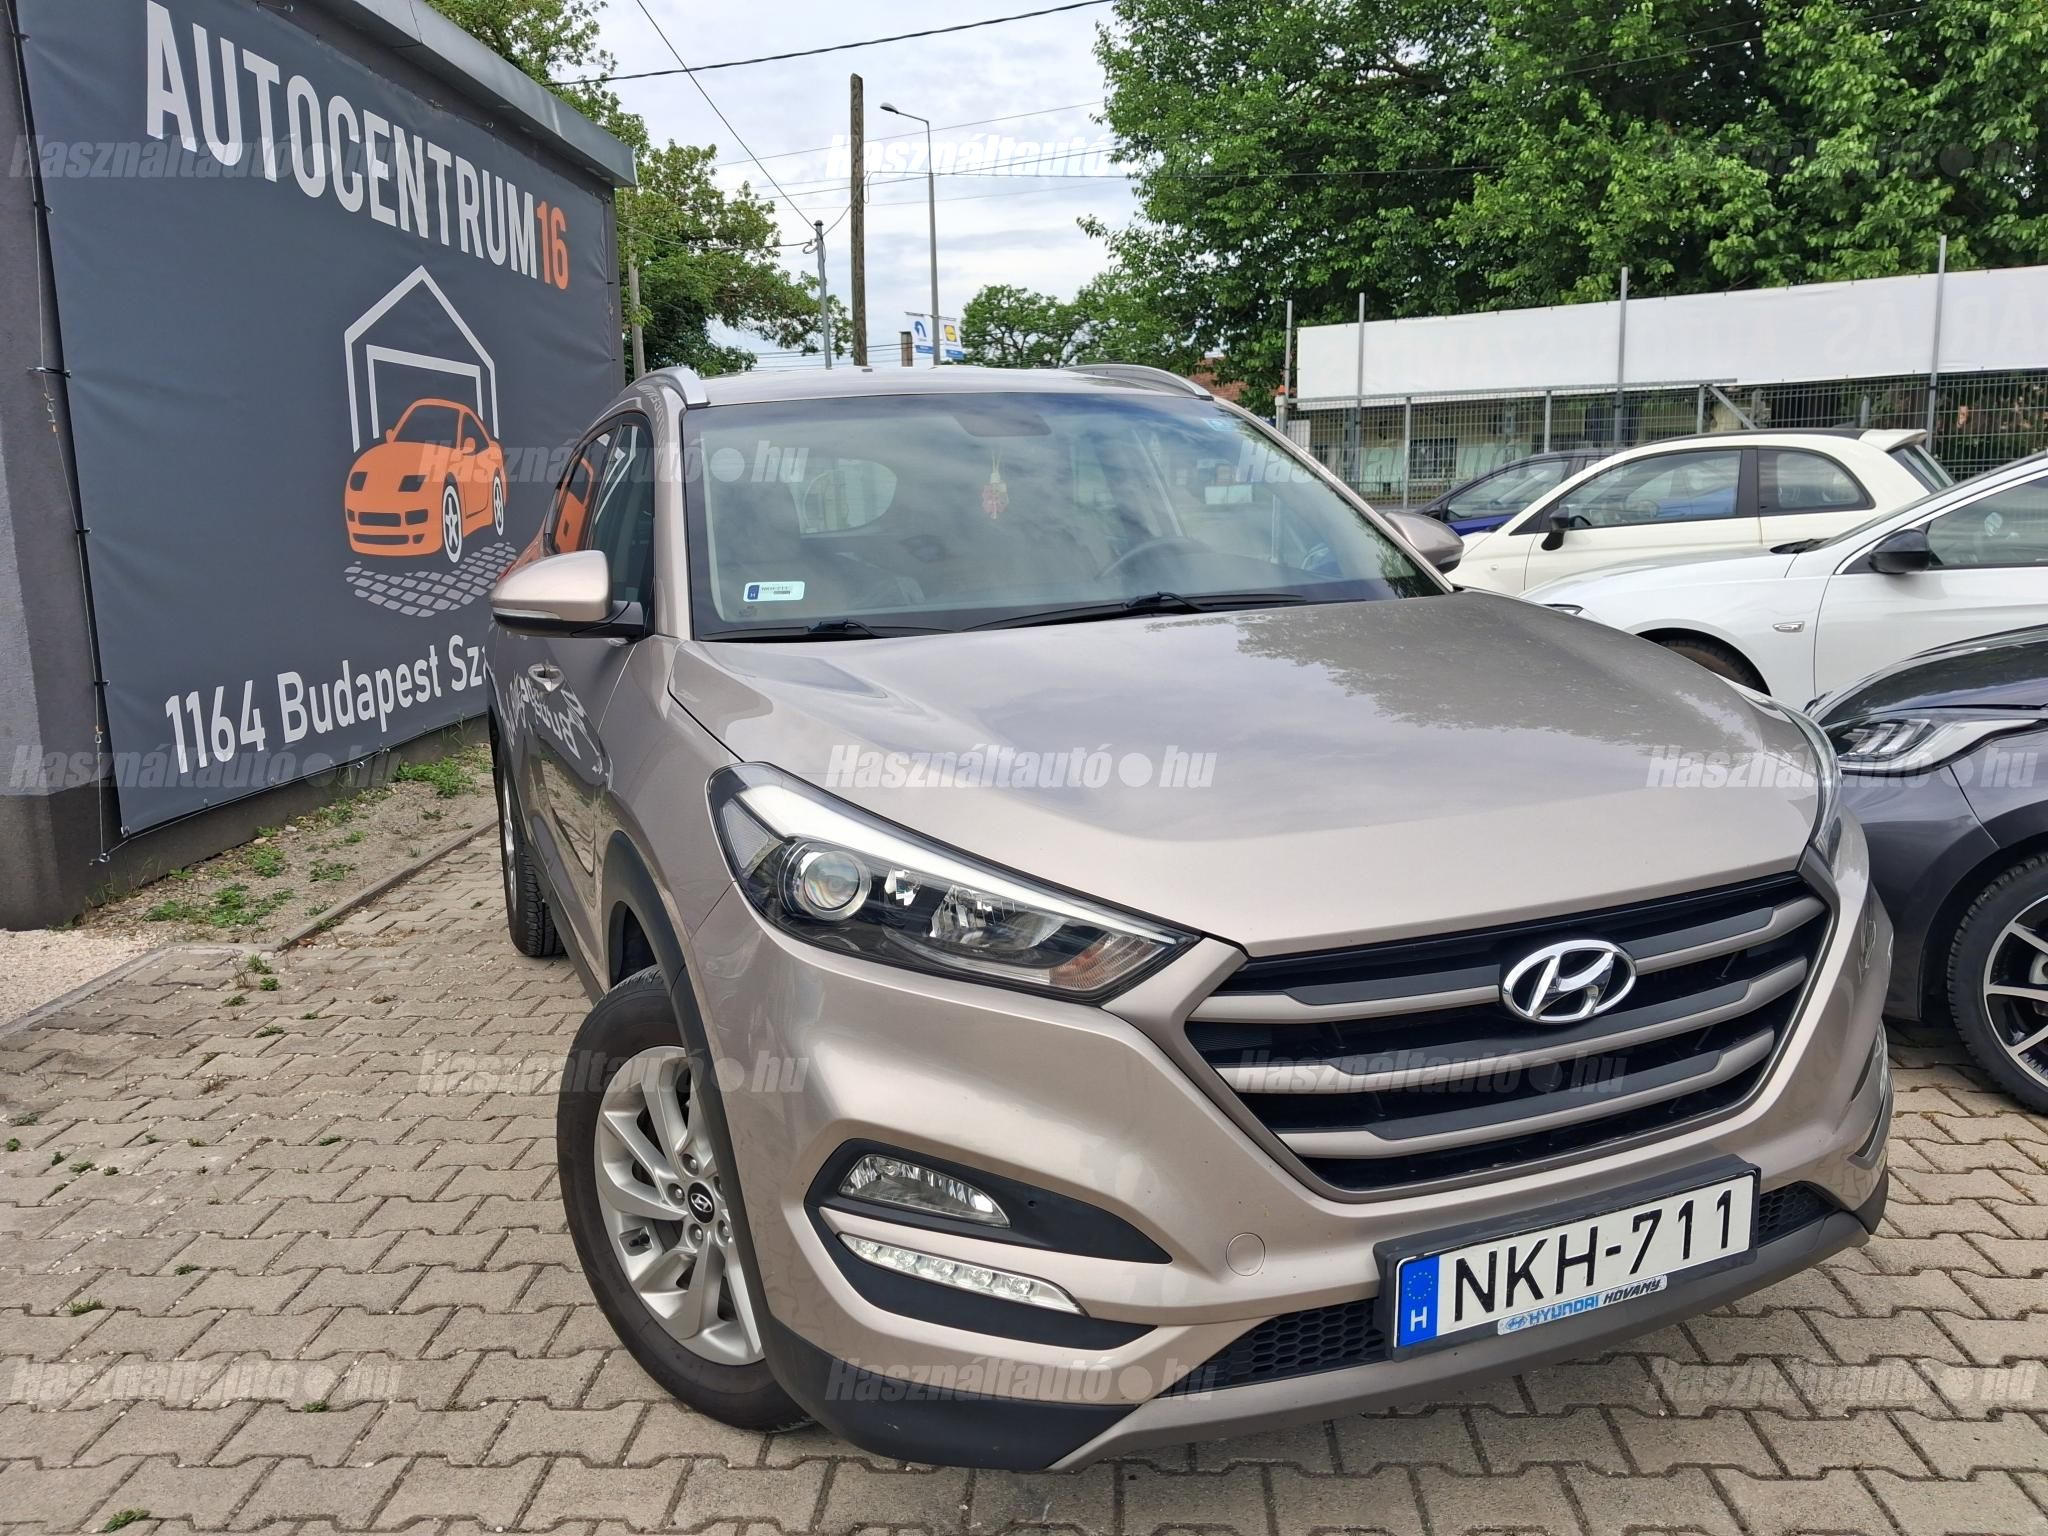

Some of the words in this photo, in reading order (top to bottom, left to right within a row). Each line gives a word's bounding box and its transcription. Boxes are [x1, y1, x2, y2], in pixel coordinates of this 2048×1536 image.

[146, 0, 569, 290] AUTOCENTRUM16
[165, 680, 266, 774] 1164
[277, 645, 442, 744] Budapest
[1410, 1306, 1428, 1332] H
[1454, 1189, 1732, 1322] NKH-711
[1529, 1295, 1601, 1326] HYUNDAI
